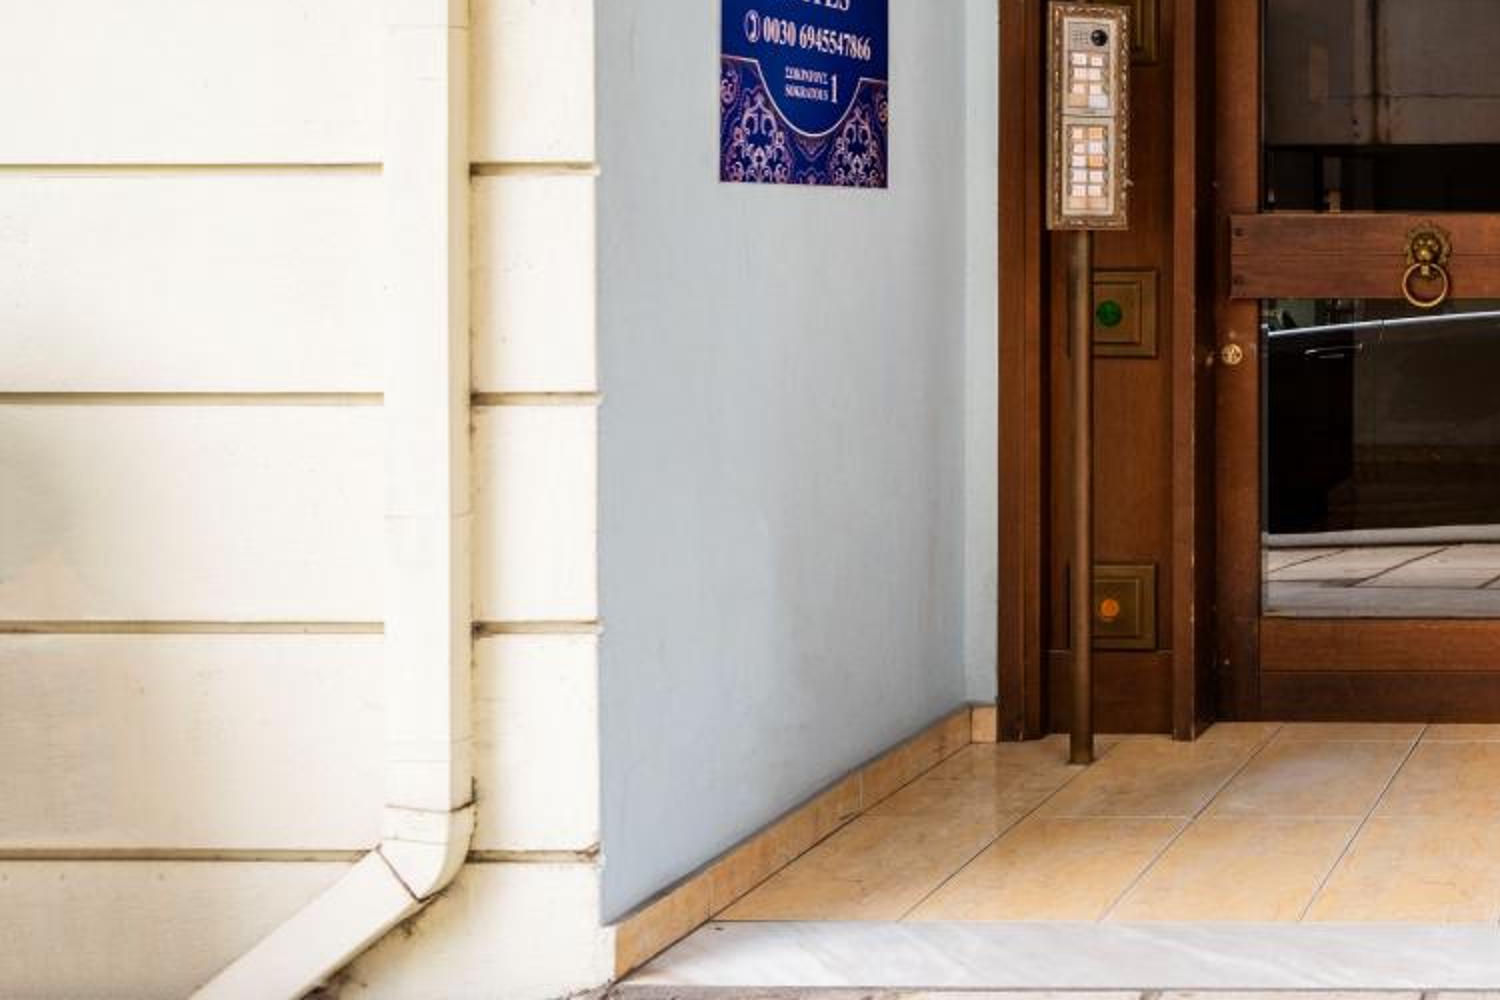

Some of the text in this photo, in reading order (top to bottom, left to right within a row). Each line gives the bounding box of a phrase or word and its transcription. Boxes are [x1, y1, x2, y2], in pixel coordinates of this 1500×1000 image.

[763, 16, 871, 60] 0030 6945547866
[831, 73, 838, 104] 1
